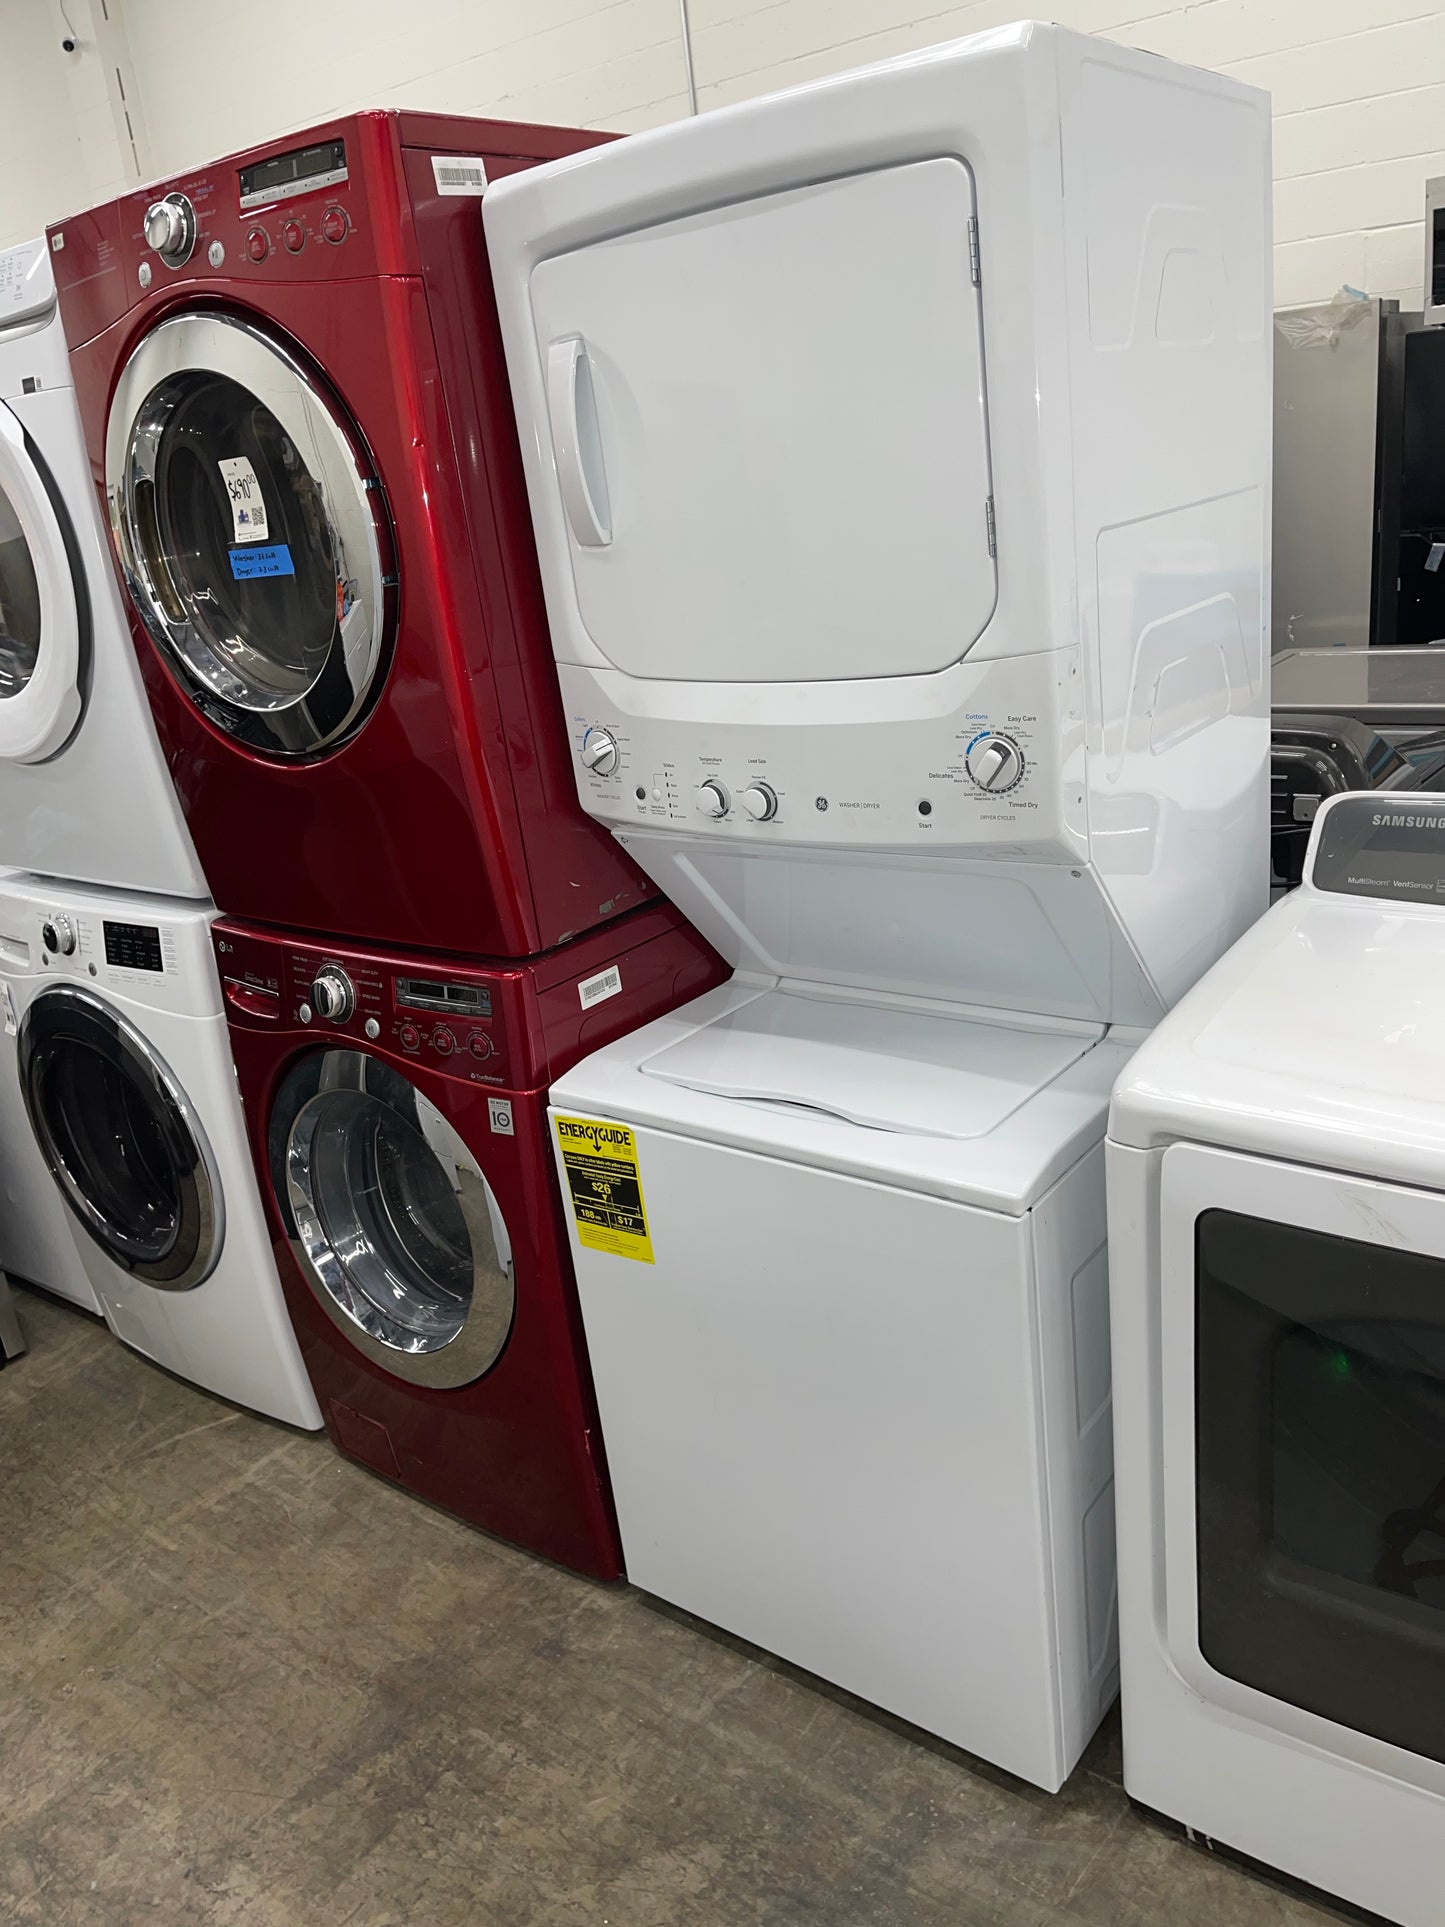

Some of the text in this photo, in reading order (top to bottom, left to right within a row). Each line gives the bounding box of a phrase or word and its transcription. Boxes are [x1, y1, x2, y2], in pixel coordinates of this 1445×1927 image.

[1372, 814, 1445, 829] SAMSUNG
[1393, 880, 1434, 890] VentSensor
[558, 1121, 631, 1146] ENERGYGUIDE
[591, 1182, 611, 1194] $26
[617, 1216, 633, 1226] $17
